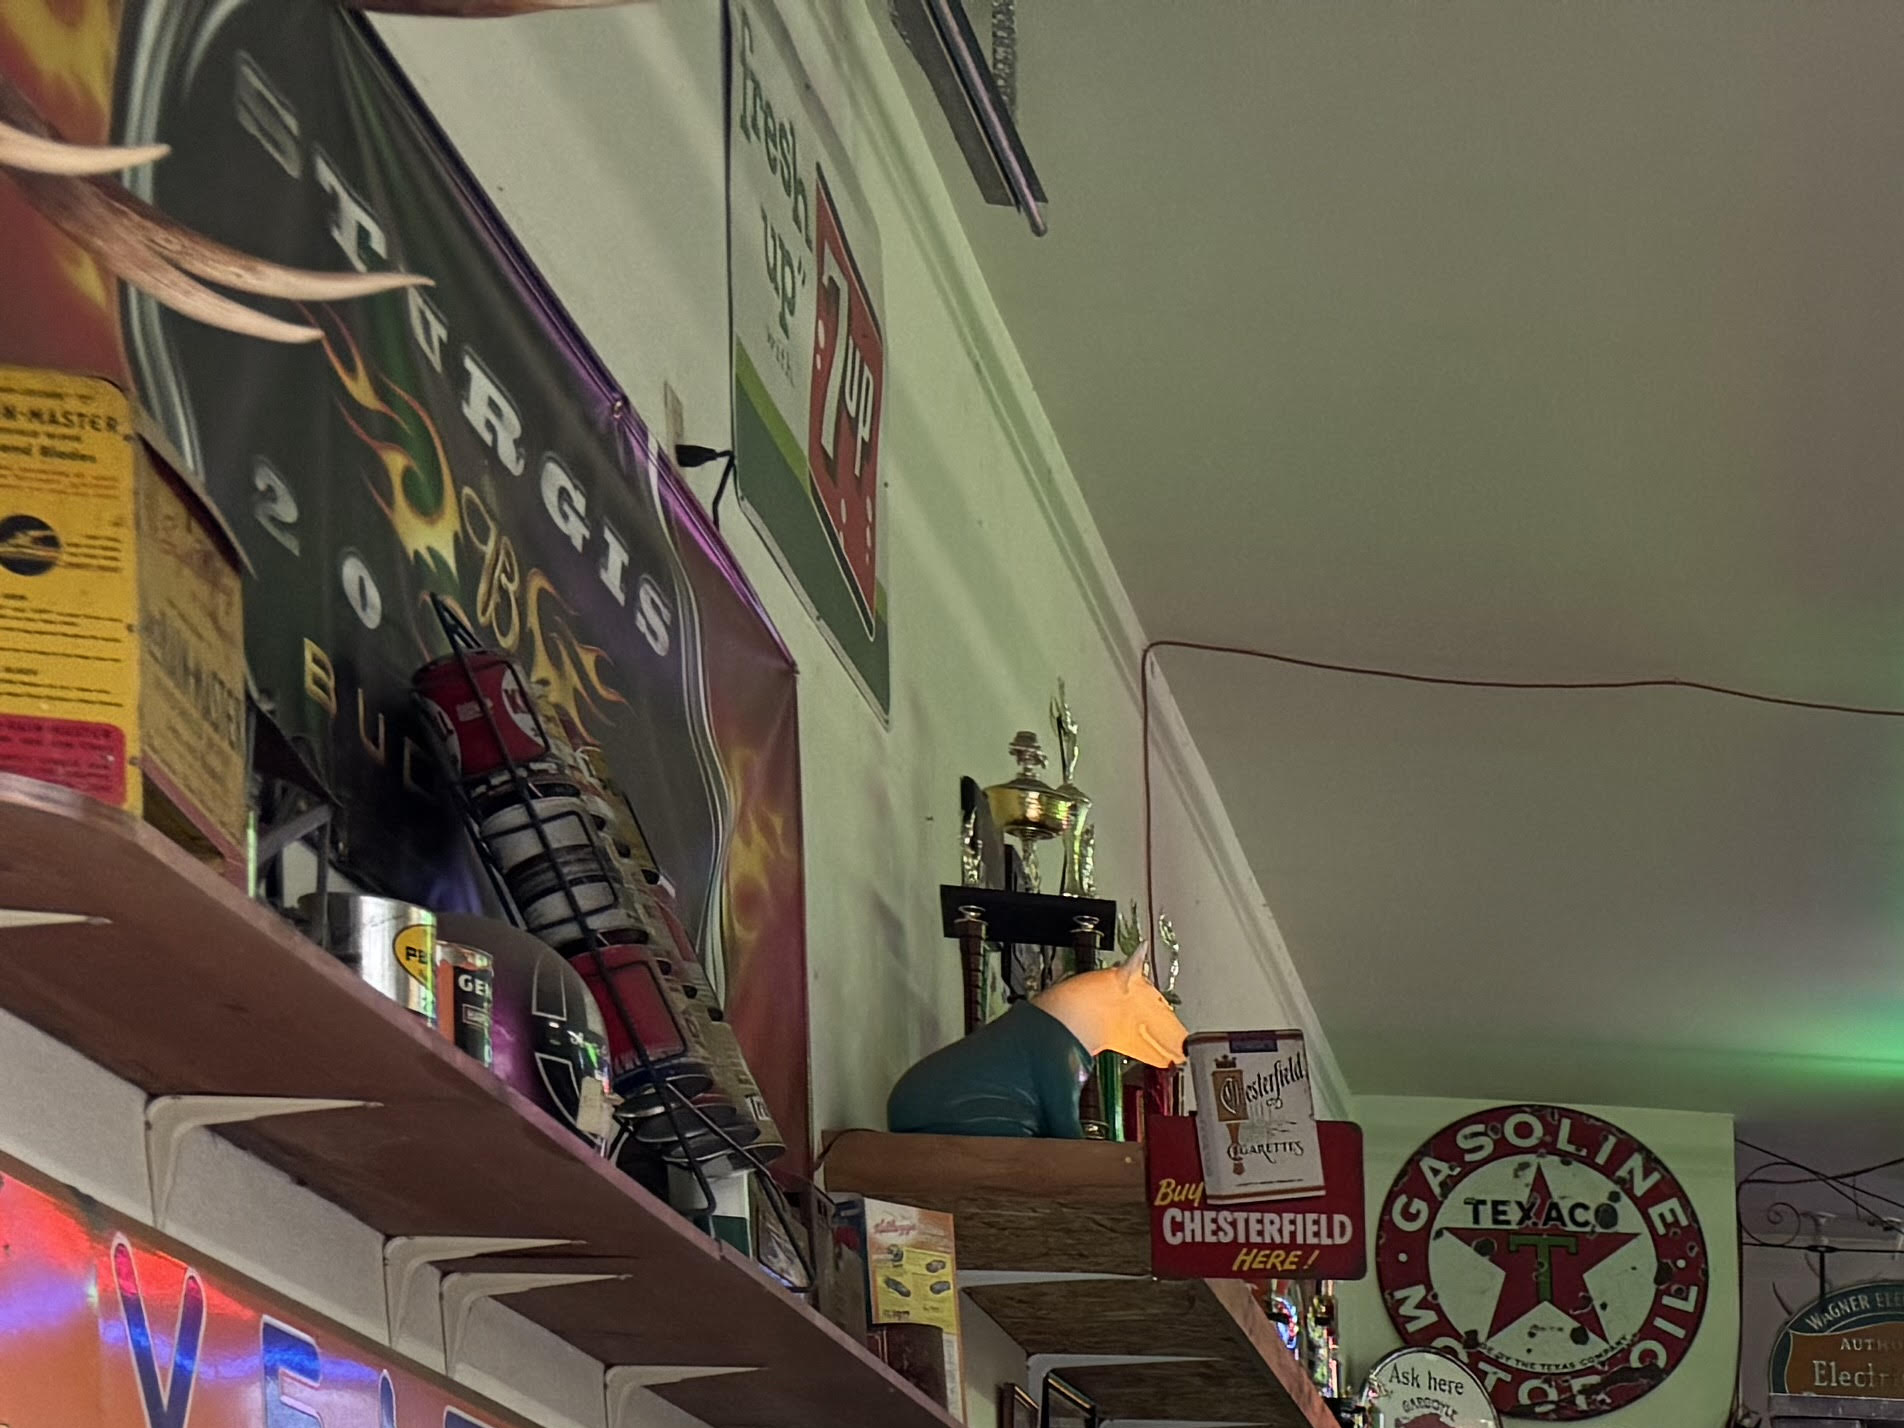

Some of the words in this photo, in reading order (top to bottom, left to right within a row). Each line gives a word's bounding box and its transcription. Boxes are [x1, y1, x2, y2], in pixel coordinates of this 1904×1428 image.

[1391, 1113, 1689, 1235] GASOLINE
[1154, 1178, 1203, 1206] Buy
[1163, 1208, 1352, 1245] CHESTERFIELD
[1464, 1198, 1619, 1229] TEXACO
[1508, 1235, 1577, 1302] T
[1630, 1285, 1699, 1372] OIL
[1389, 1363, 1421, 1388] Ask
[1428, 1371, 1464, 1395] here
[1540, 1361, 1573, 1372] TEXAS
